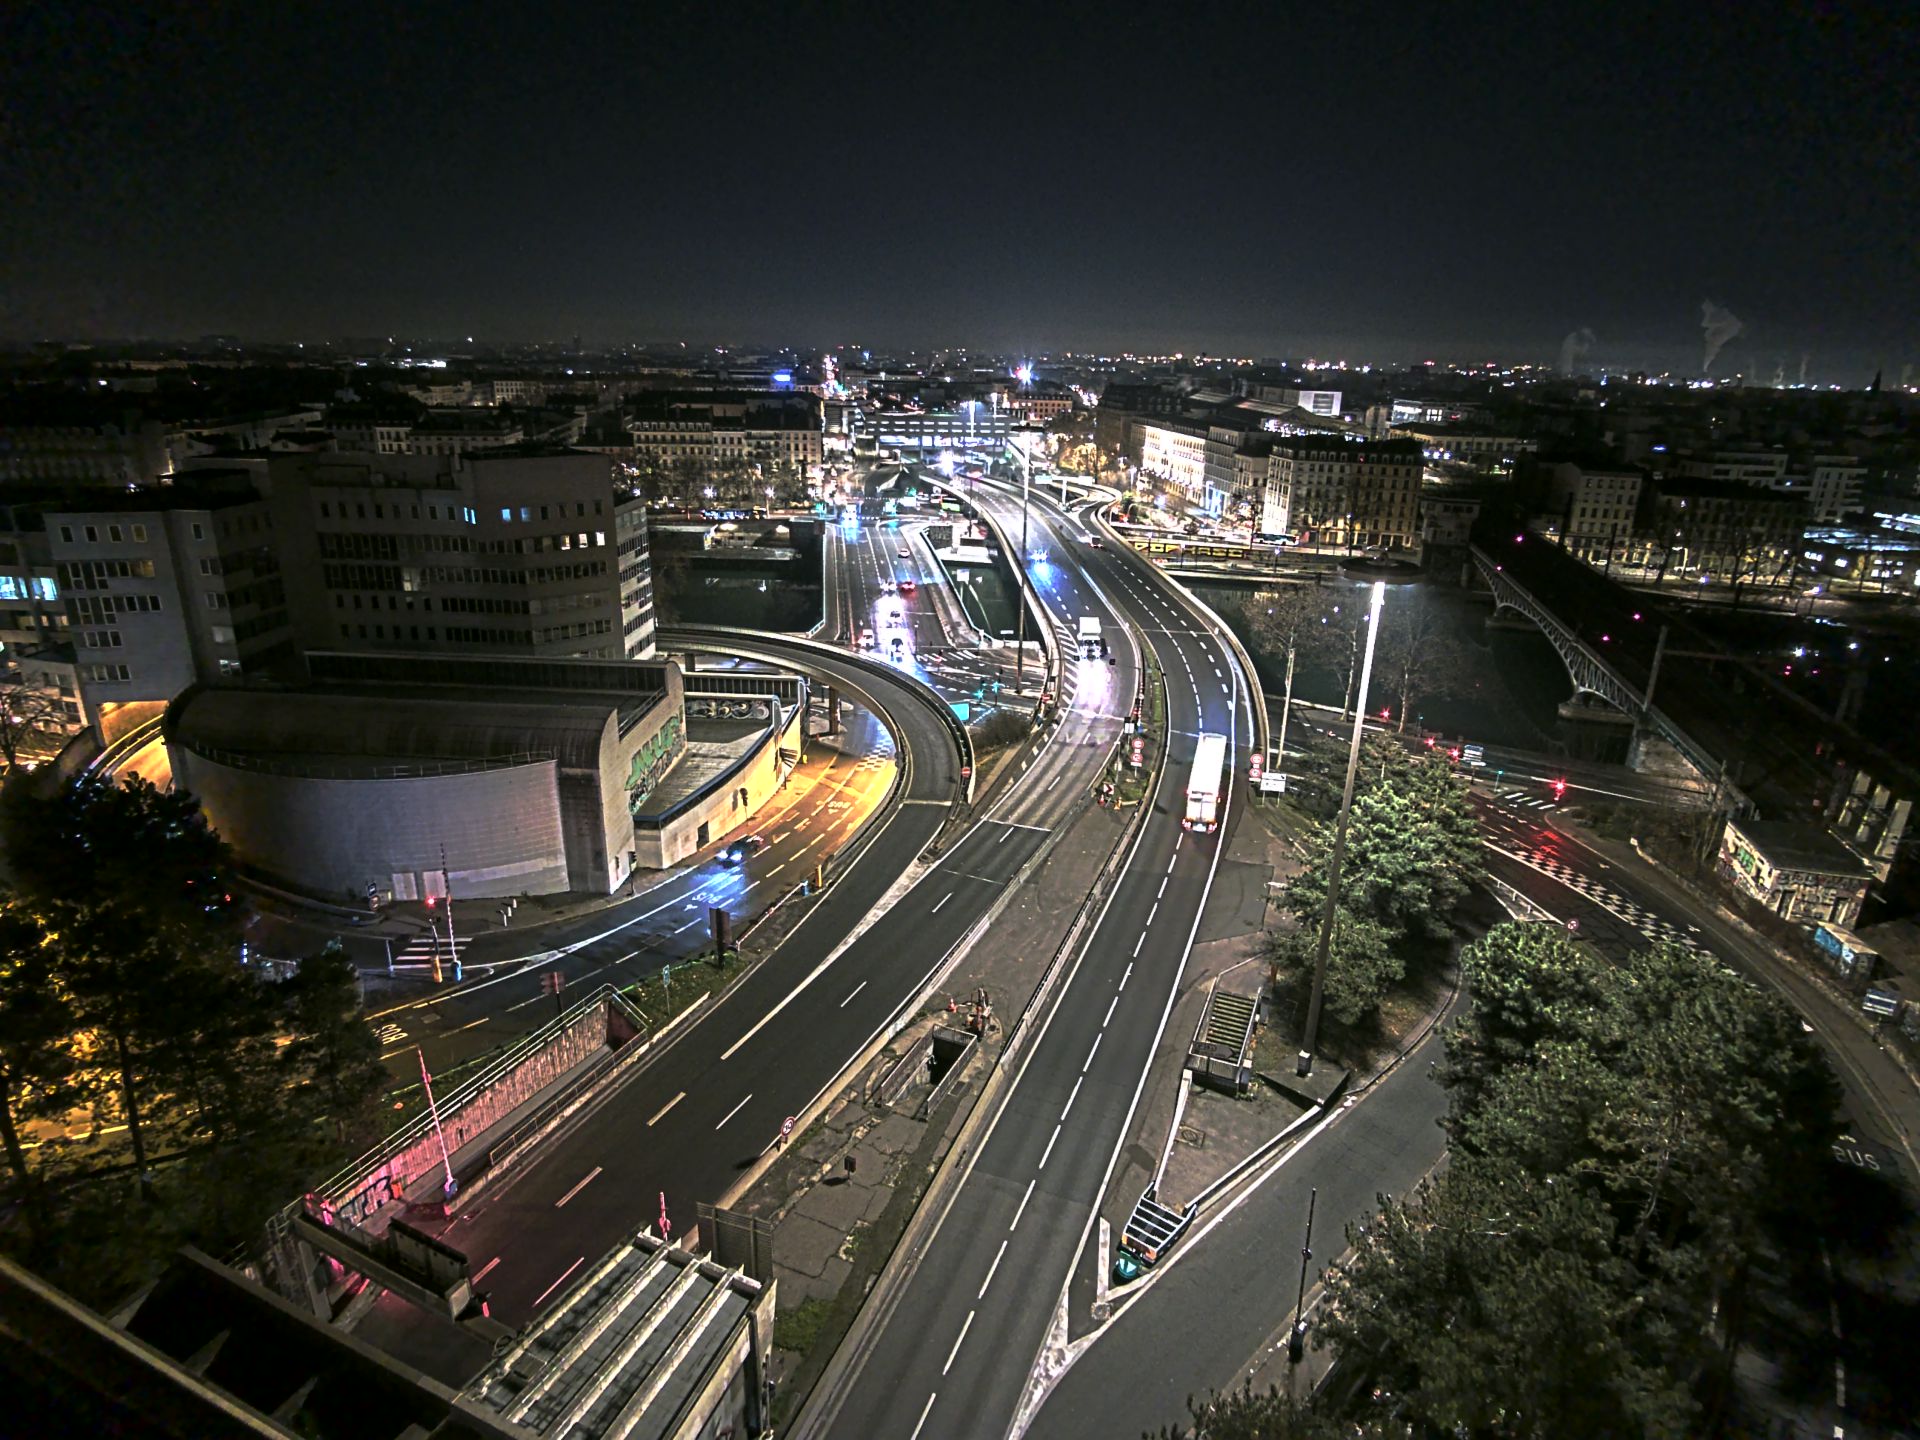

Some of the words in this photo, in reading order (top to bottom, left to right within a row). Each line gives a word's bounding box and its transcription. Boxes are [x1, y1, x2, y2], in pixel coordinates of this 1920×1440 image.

[827, 800, 852, 809] BUS
[692, 892, 723, 904] BUS
[381, 1023, 408, 1045] BUS
[1831, 1145, 1881, 1171] BUS
